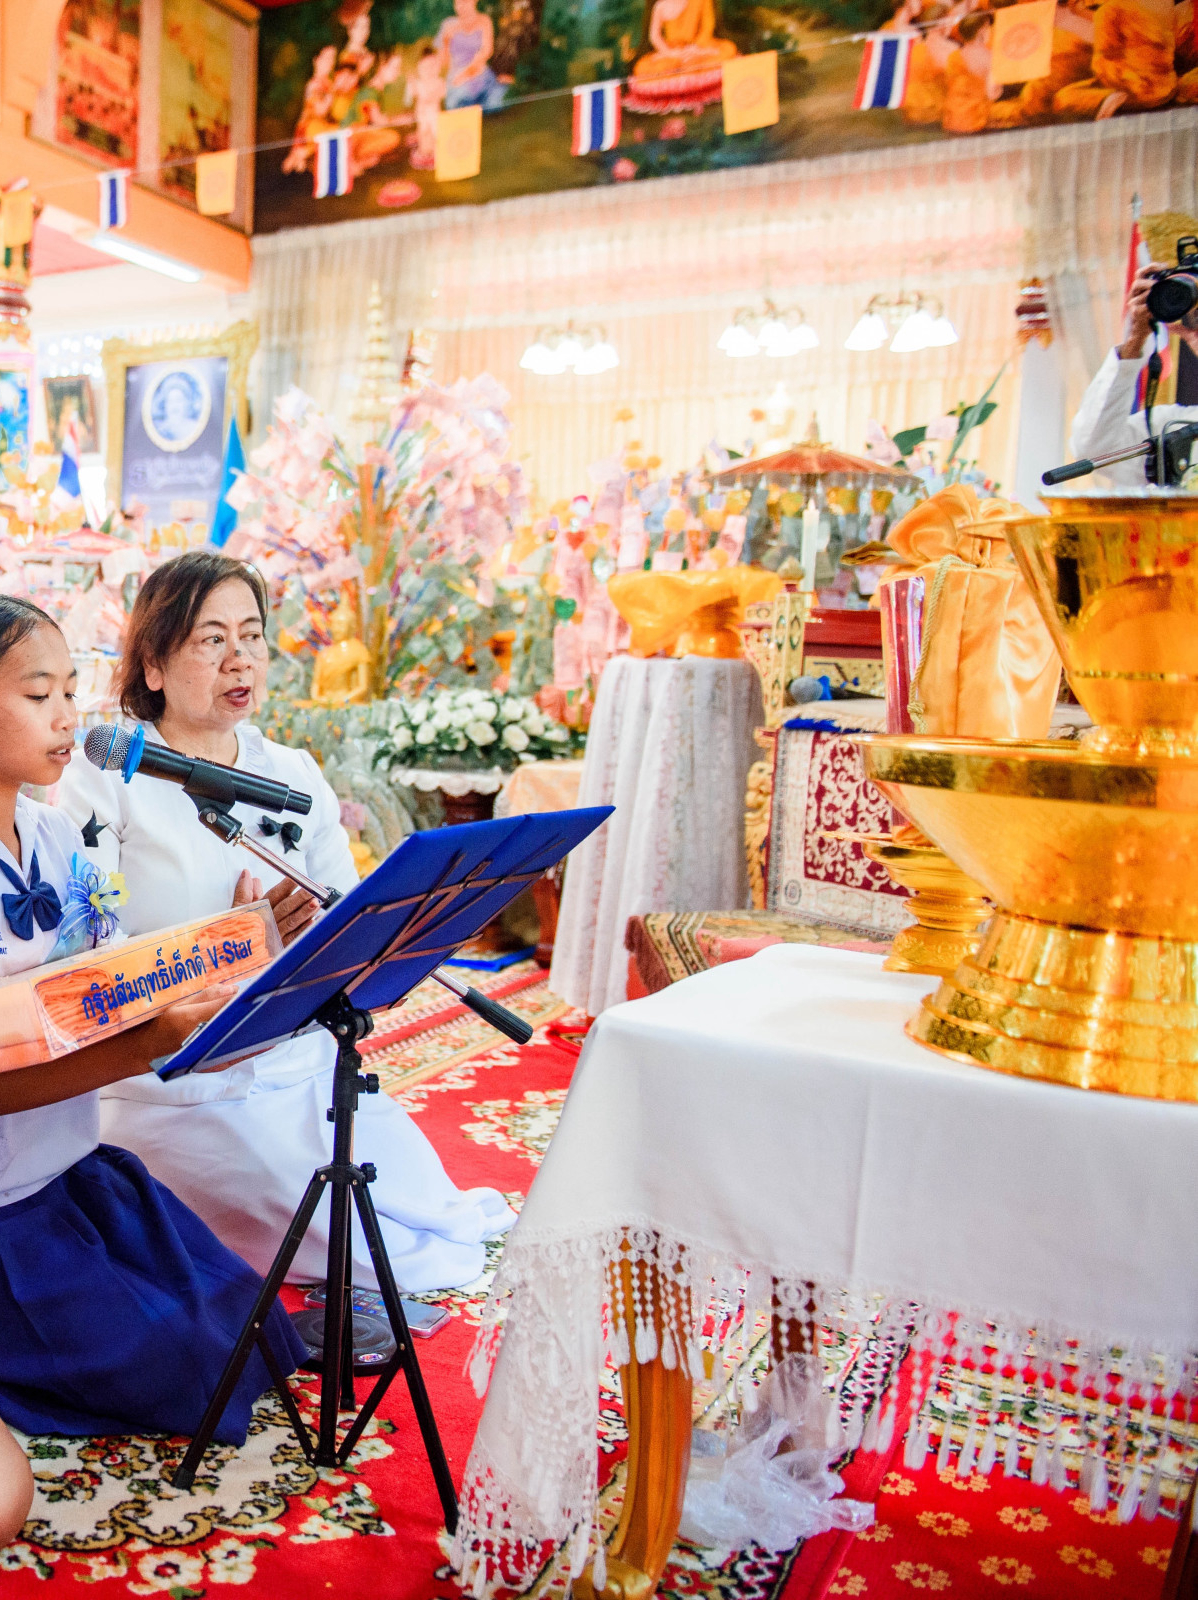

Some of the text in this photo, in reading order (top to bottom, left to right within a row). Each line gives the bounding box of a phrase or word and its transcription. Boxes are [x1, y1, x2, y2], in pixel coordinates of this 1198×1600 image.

[82, 938, 254, 1026] กฐินสัมฤทธิ์เด็กดี V-Star
